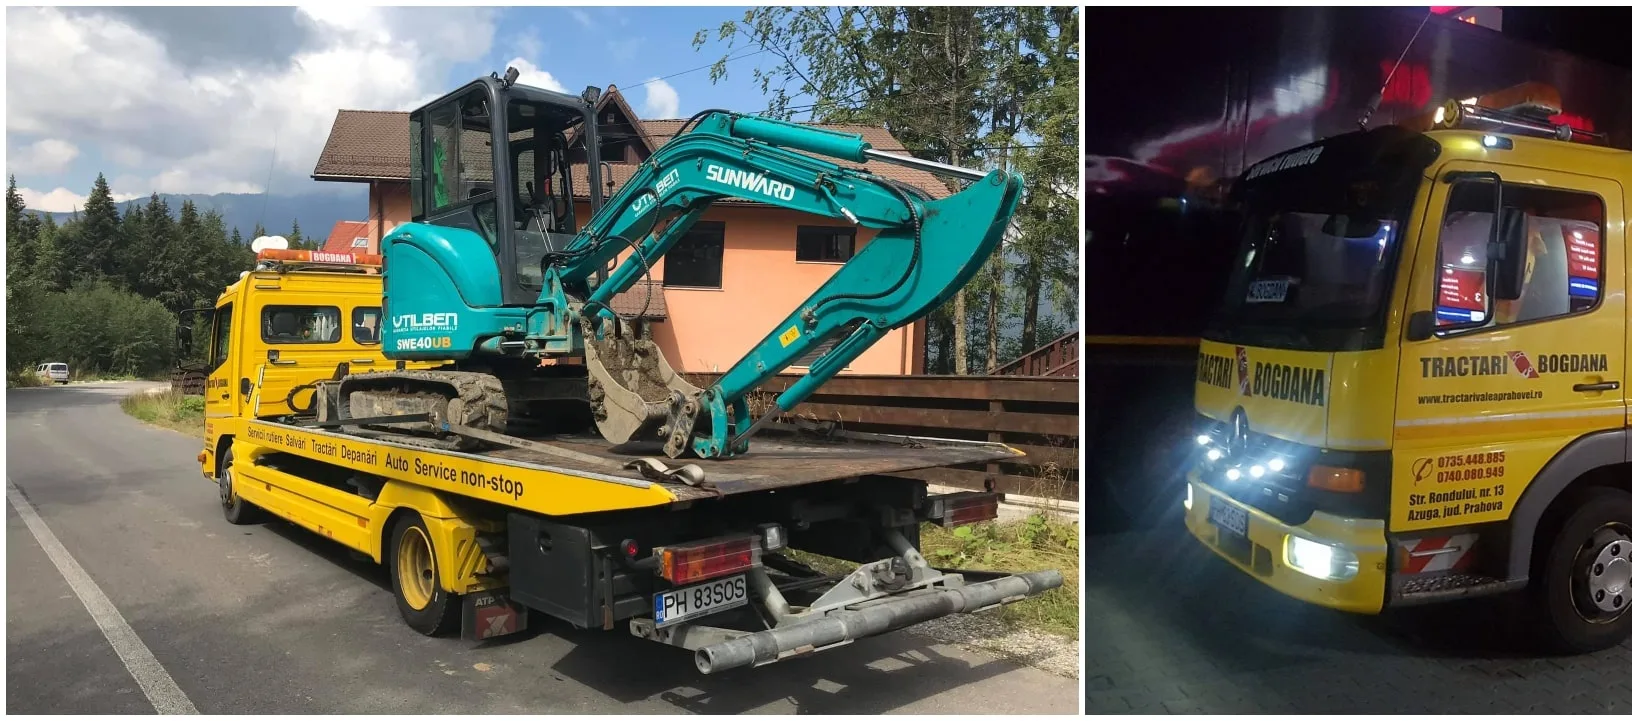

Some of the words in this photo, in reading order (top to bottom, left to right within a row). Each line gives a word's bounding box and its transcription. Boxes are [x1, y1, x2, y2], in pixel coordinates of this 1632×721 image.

[706, 164, 795, 201] SUNWARD
[314, 252, 352, 262] BOGDANA
[392, 312, 458, 328] UTILBEN
[396, 336, 452, 350] SWE40UB
[1420, 355, 1508, 378] TRACTARI
[1538, 354, 1608, 373] BOGDANA
[1253, 362, 1324, 406] BOGDANA
[1418, 390, 1542, 404] www.tractarivaleaprahovei.ro
[248, 426, 266, 440] Servicii
[266, 432, 283, 444] rutiere
[342, 444, 377, 466] Depanări
[386, 452, 408, 472] Auto
[415, 458, 456, 482] Service
[461, 470, 524, 500] non-stop
[1438, 452, 1505, 468] 0735.448.885
[1437, 466, 1504, 483] 0740.080.949
[1410, 494, 1426, 506] Str.
[1480, 488, 1491, 498] nr.
[1494, 484, 1504, 496] 13
[1443, 504, 1462, 518] jud.
[1464, 500, 1502, 514] Prahova
[475, 596, 495, 606] ATP
[664, 591, 688, 618] PH
[694, 578, 744, 610] 83SOS
